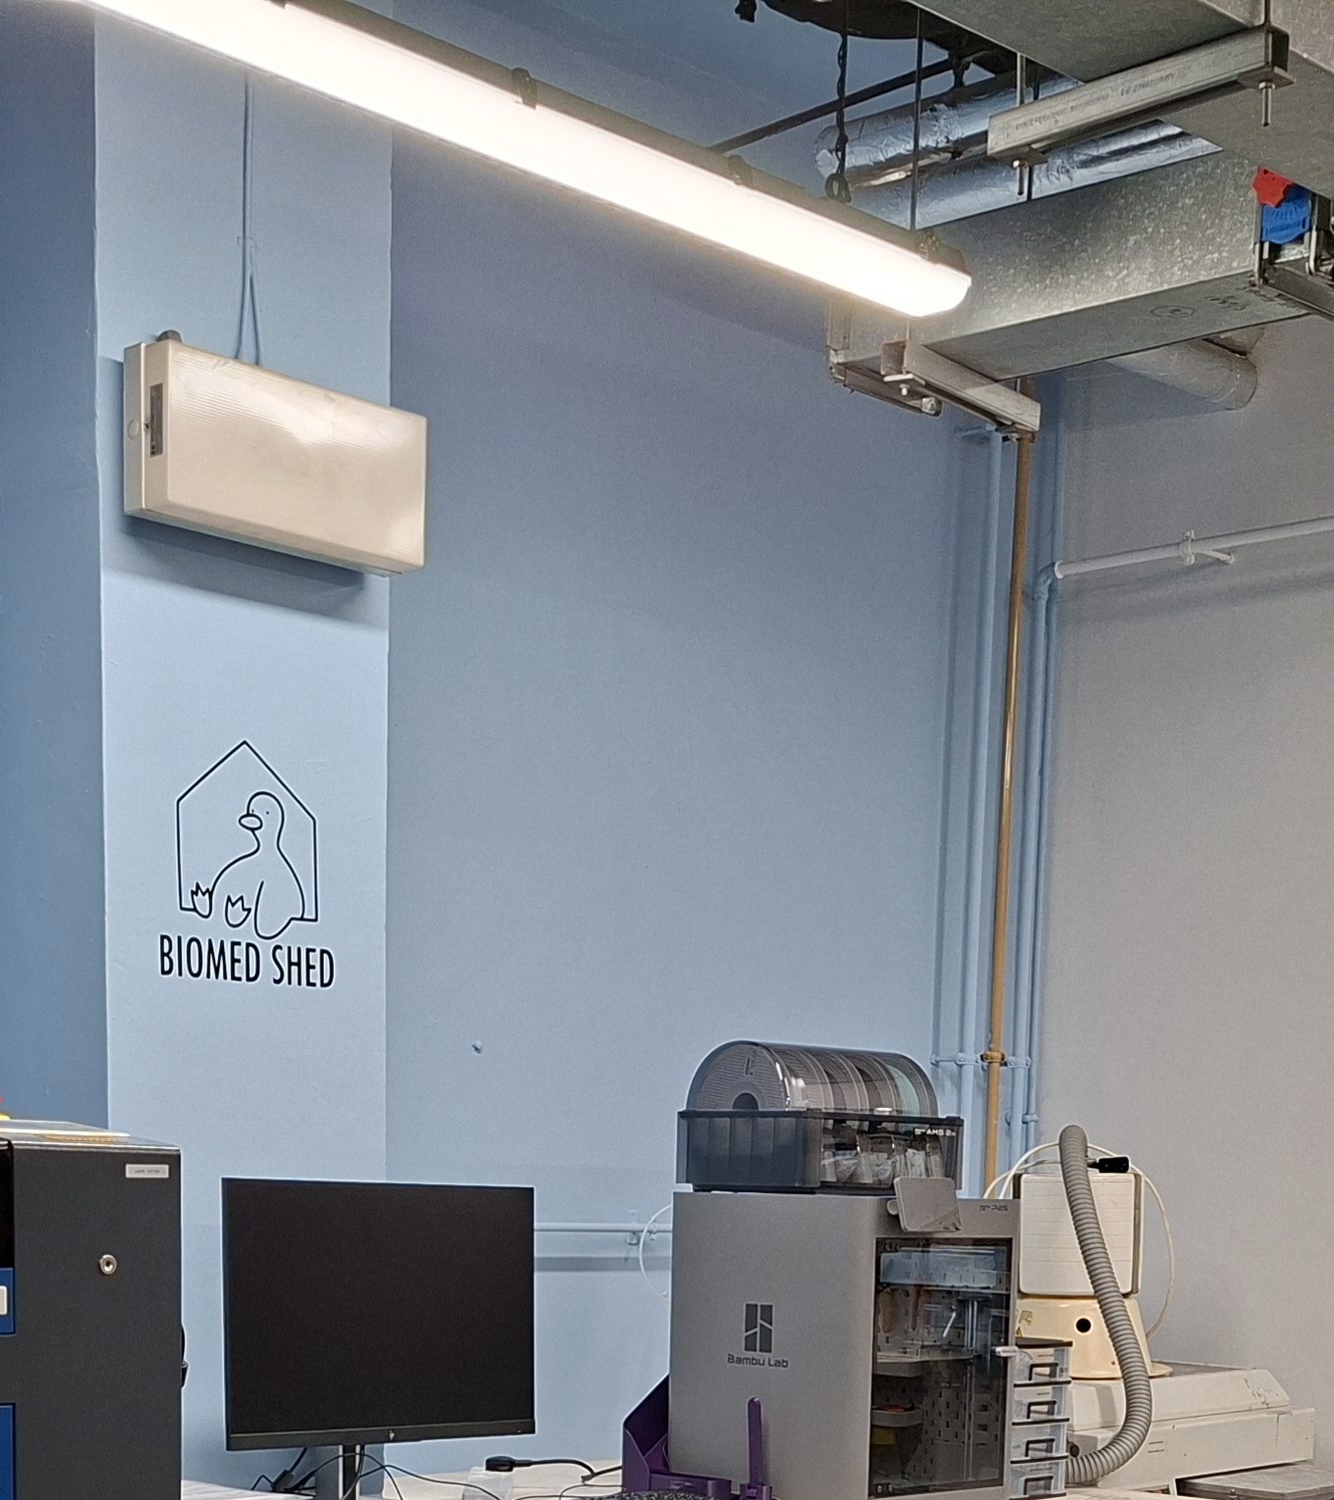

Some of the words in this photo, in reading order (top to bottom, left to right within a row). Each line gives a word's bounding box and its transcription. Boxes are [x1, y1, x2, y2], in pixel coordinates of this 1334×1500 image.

[160, 934, 261, 983] BIOMED
[272, 944, 335, 988] SHED
[727, 1353, 766, 1367] Bambu
[767, 1357, 789, 1369] Lab
